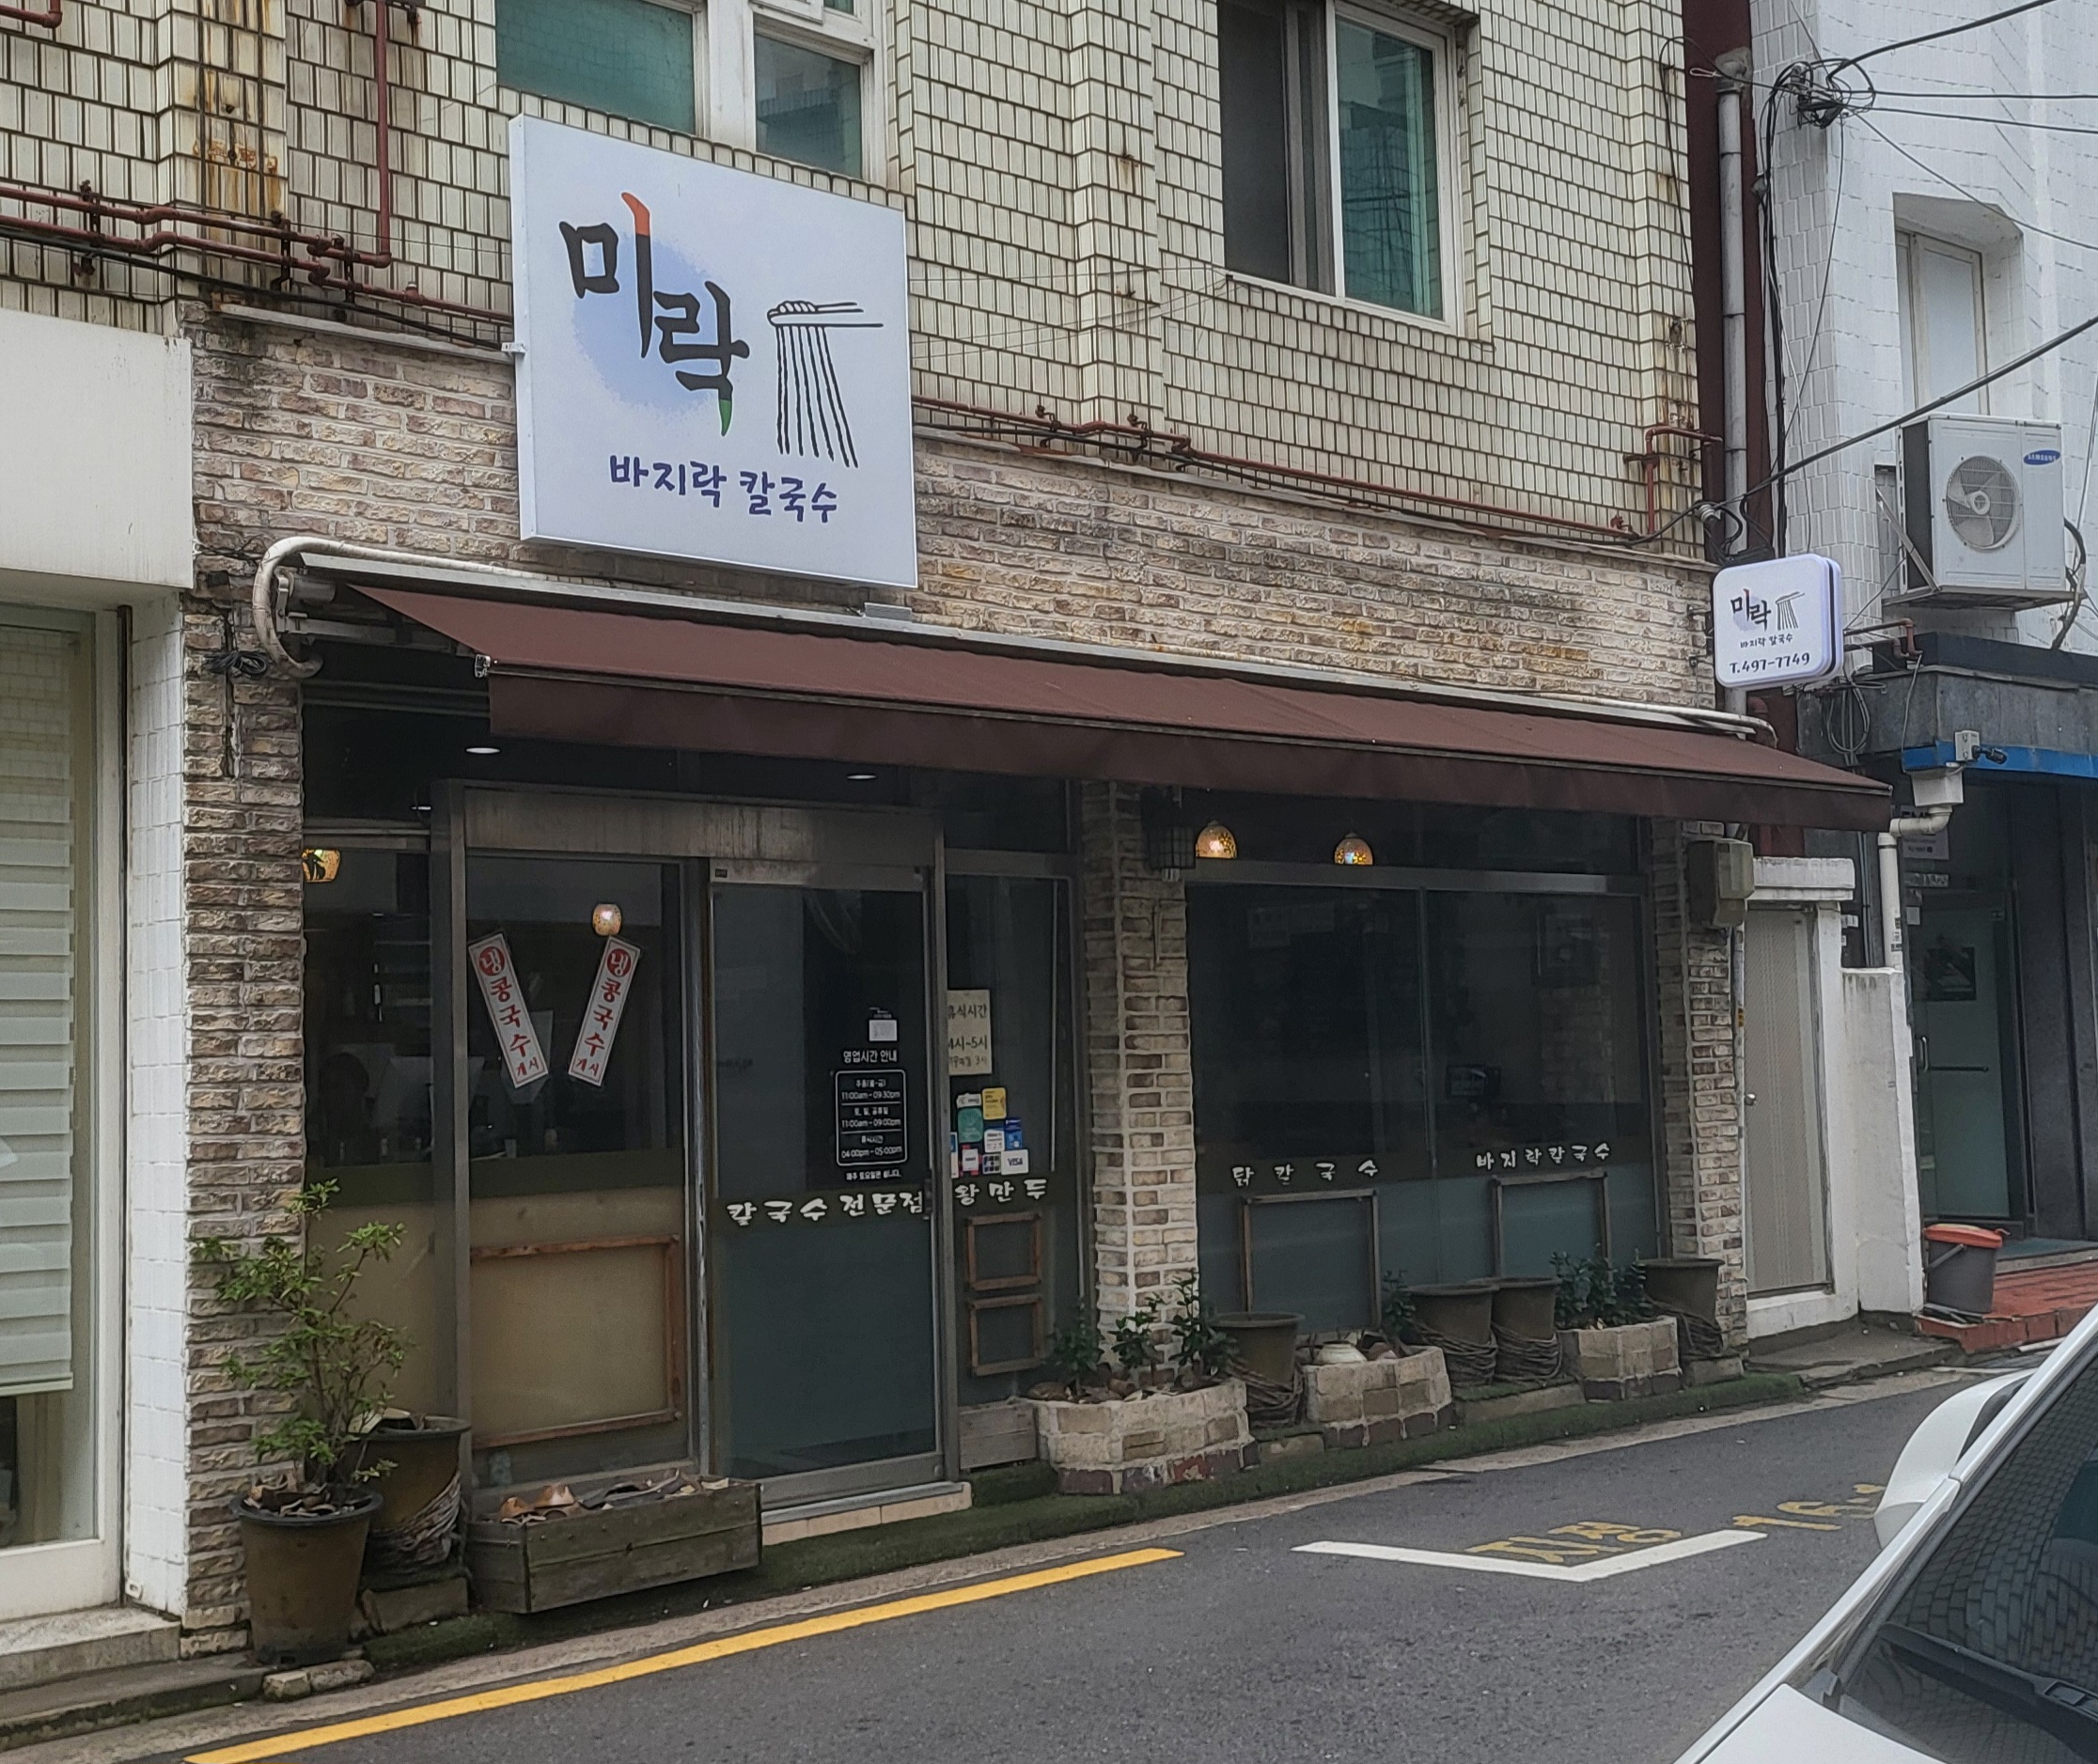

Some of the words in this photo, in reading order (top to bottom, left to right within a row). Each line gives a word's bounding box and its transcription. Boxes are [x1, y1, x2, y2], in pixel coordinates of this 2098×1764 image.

[559, 192, 749, 435] 미락
[609, 455, 727, 507] 바지락
[739, 471, 838, 523] 칼국수
[1730, 588, 1772, 632] 미락
[1740, 636, 1766, 648] 바지락
[1769, 632, 1793, 647] 칼국수
[1730, 652, 1810, 674] T.497-7749
[843, 1050, 878, 1064] 영업시간
[880, 1050, 898, 1063] 안내
[727, 1198, 828, 1226] 칼국수
[839, 1191, 923, 1217] 전문점
